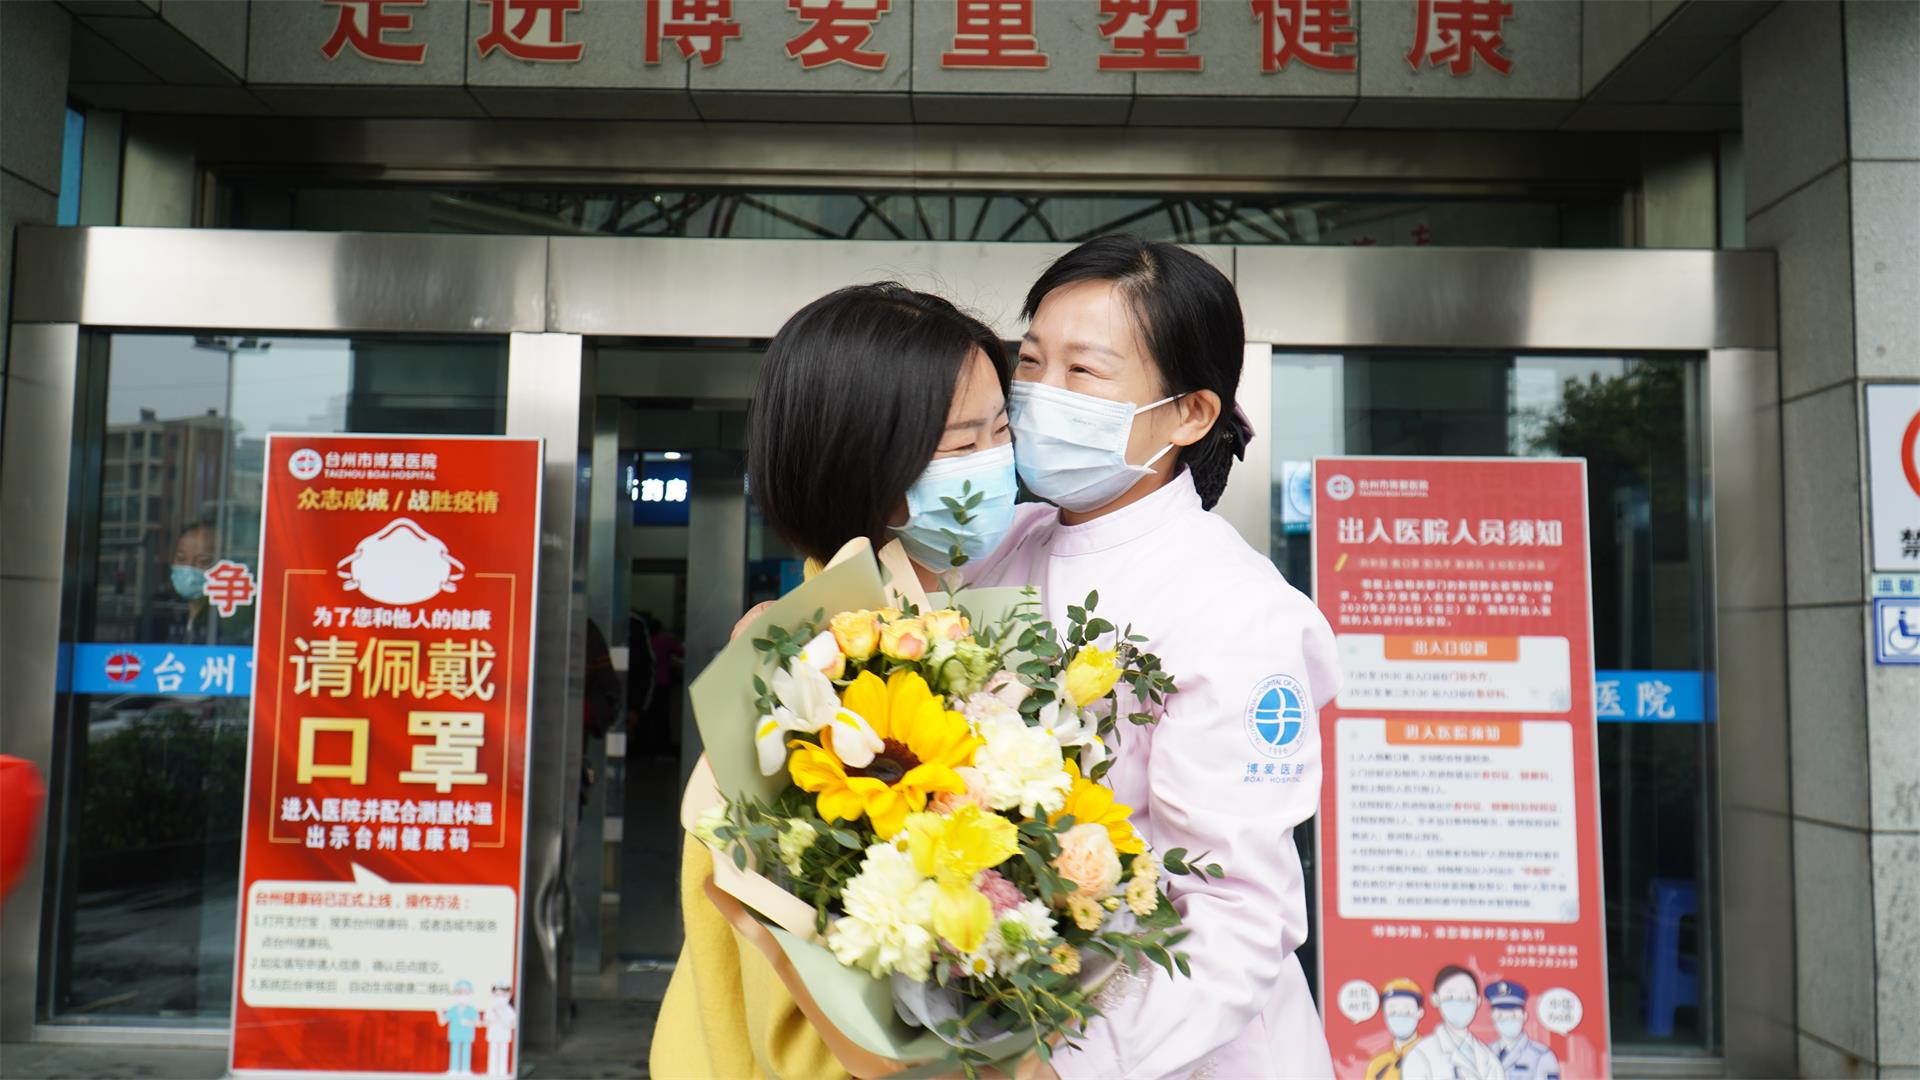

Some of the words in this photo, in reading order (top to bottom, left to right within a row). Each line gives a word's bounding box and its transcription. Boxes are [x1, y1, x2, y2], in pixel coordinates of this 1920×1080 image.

[325, 452, 438, 469] 台州市博爱医院
[297, 487, 390, 512] 众志成城
[407, 489, 499, 513] 战胜疫情
[632, 478, 687, 502] 药房
[1337, 517, 1563, 546] 出入医院人员须知
[204, 560, 256, 617] 争
[312, 607, 492, 629] 为了您和他人的健康
[153, 652, 254, 693] 台州
[289, 635, 496, 701] 请佩戴
[1596, 680, 1676, 719] 医院
[297, 711, 488, 793] 口罩
[281, 797, 494, 826] 进入医院并配合测量体温
[305, 825, 470, 852] 出示台州健康码
